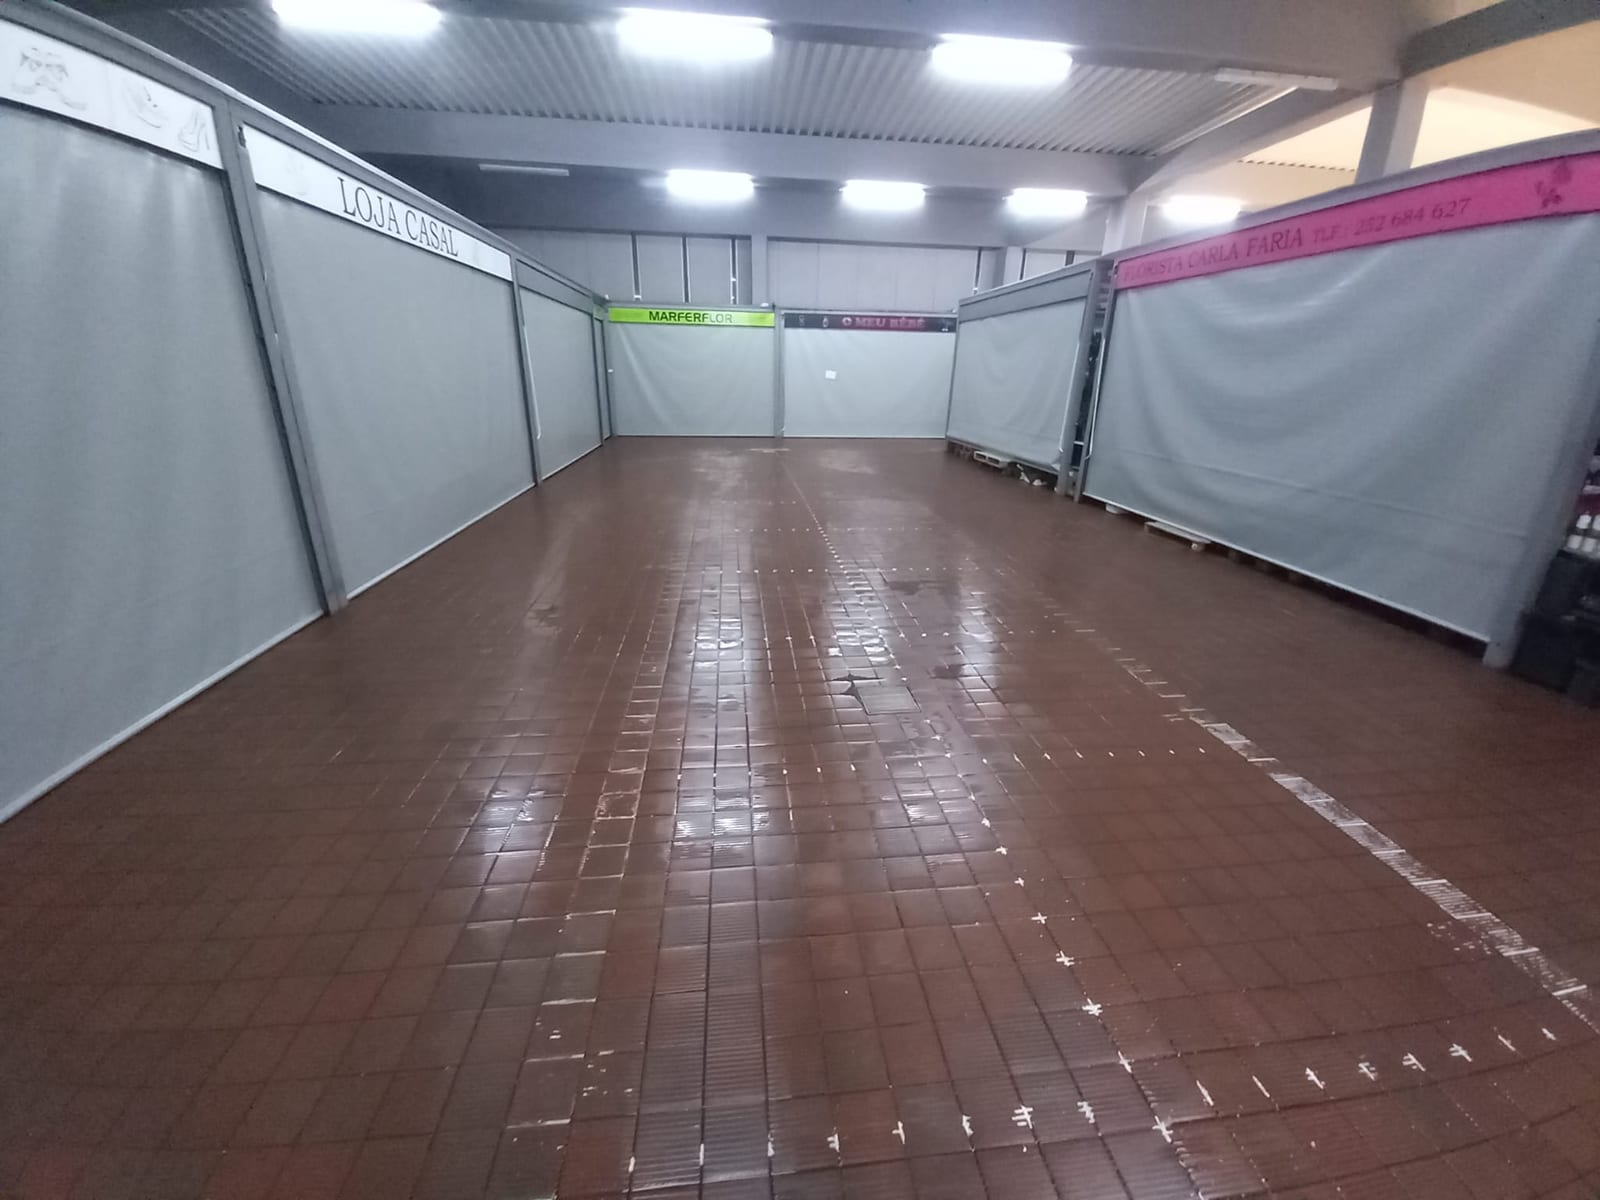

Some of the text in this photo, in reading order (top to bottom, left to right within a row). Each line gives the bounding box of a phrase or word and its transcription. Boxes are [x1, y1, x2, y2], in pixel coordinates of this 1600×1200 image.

[337, 177, 458, 257] LOJA CASAL
[1188, 242, 1239, 269] CARLA
[1246, 227, 1303, 257] FARIA
[1391, 206, 1425, 228] 684
[1432, 198, 1472, 220] 627
[648, 310, 734, 325] MARFERFLOR
